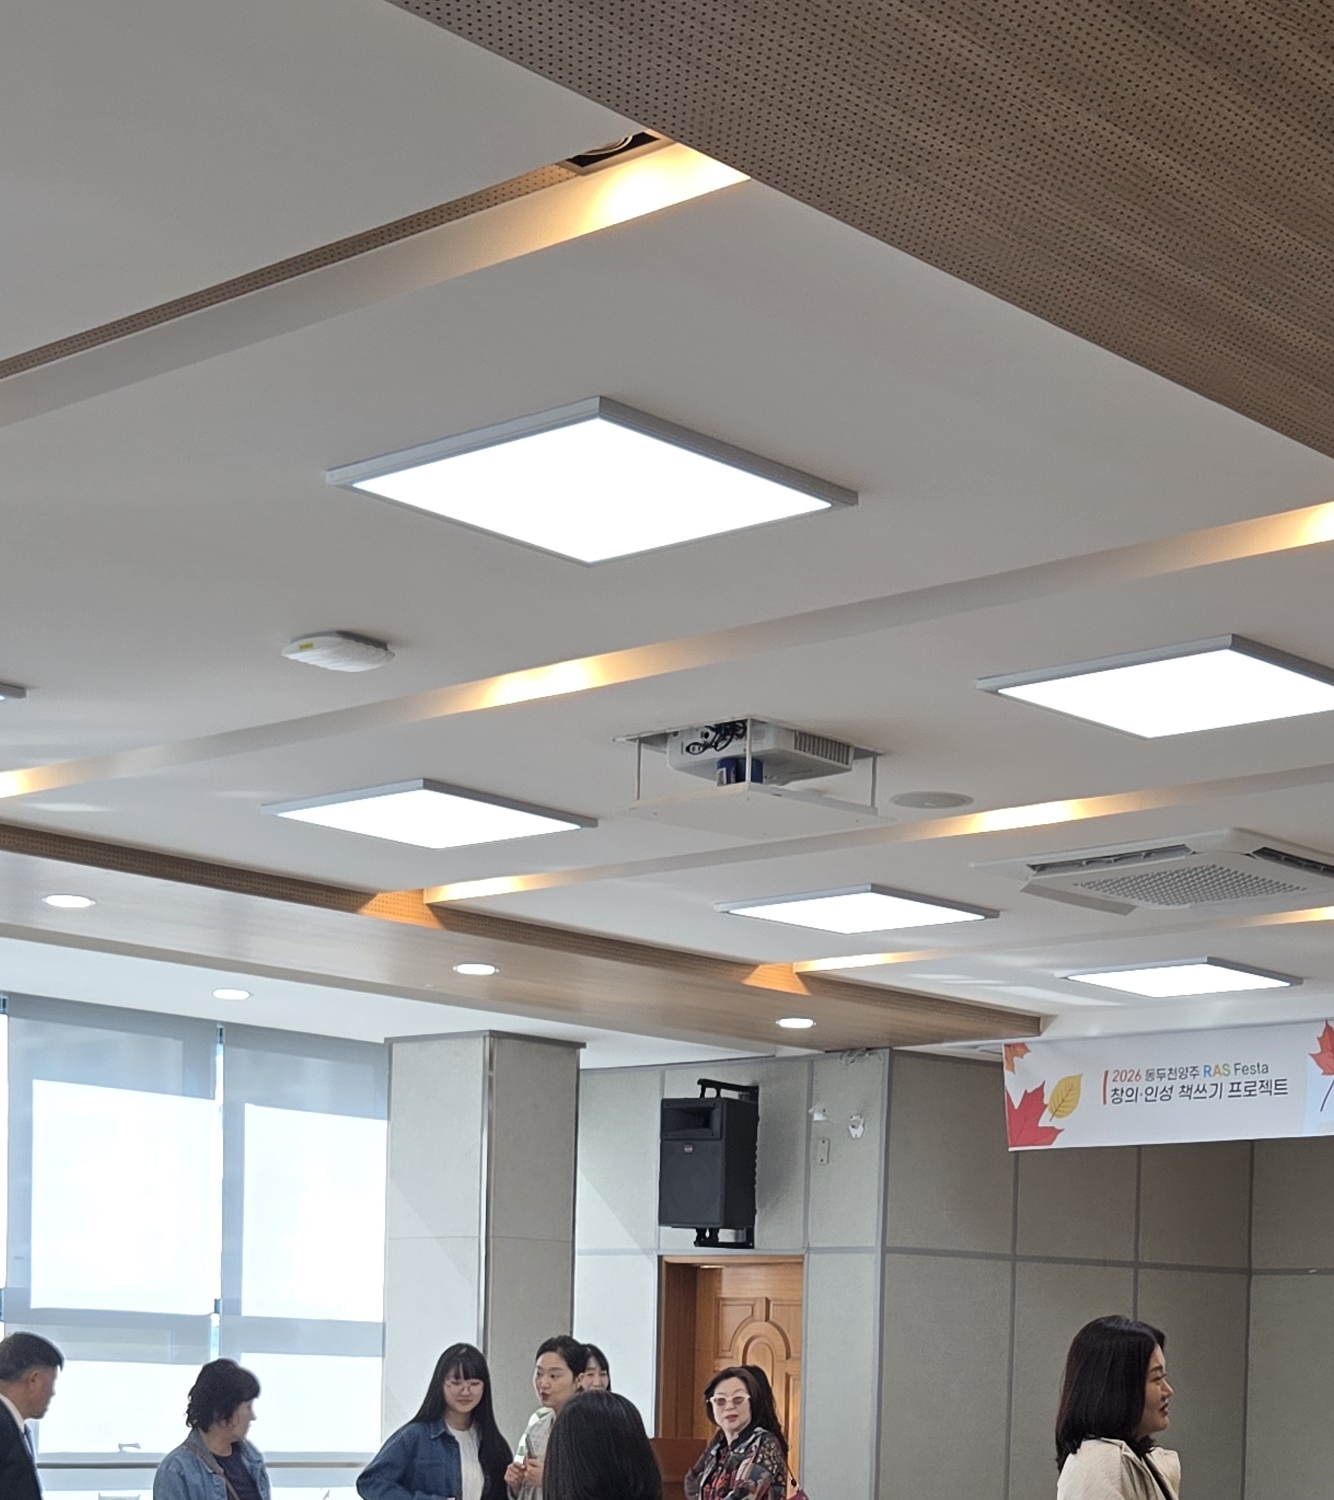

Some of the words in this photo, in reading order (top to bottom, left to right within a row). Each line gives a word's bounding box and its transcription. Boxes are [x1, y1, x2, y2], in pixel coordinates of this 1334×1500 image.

[1112, 1069, 1142, 1083] 2026
[1144, 1065, 1200, 1082] 동두천양주
[1203, 1063, 1231, 1078] RAS
[1233, 1061, 1269, 1076] Festa
[1110, 1085, 1174, 1105] 창의·인성
[1178, 1082, 1223, 1100] 책쓰기
[1227, 1078, 1289, 1098] 프로젝트
